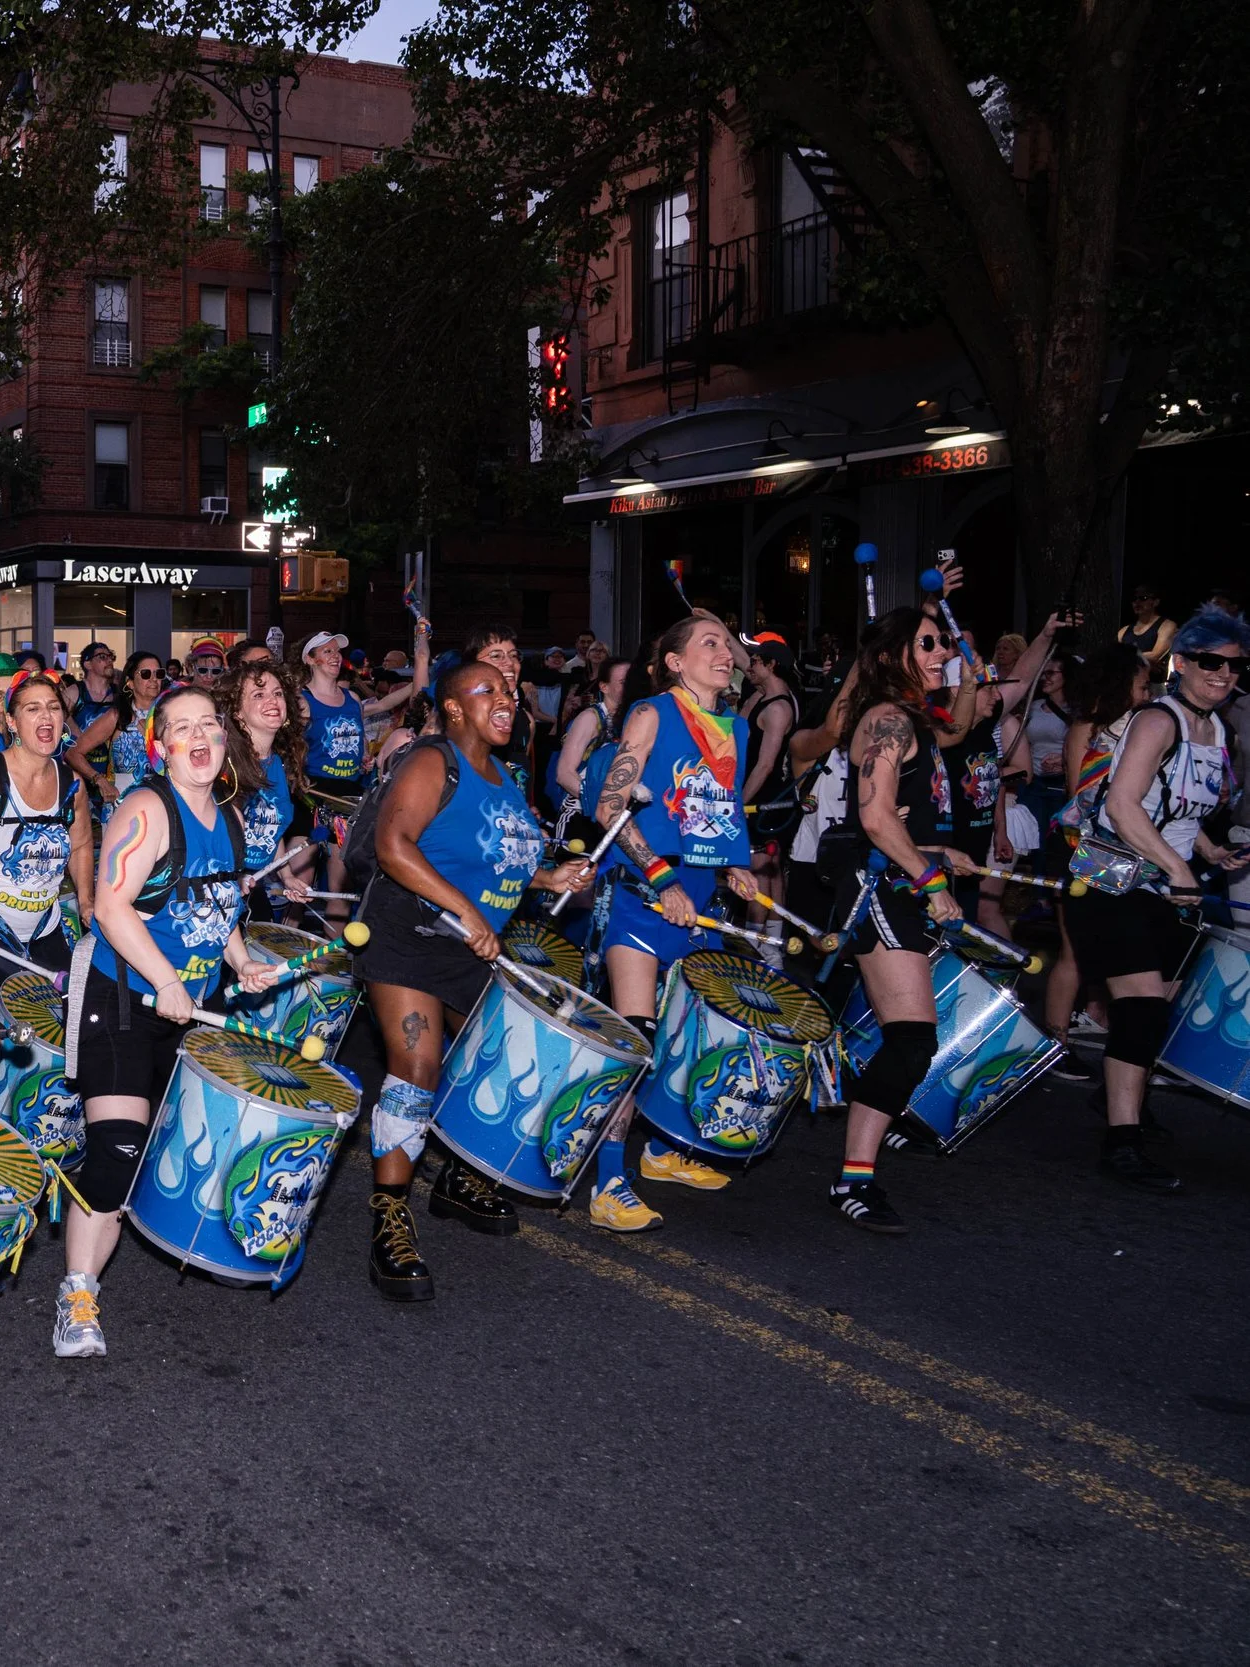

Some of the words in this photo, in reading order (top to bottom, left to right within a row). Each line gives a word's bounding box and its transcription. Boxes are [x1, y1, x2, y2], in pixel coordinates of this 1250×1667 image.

[610, 495, 635, 514] Kiku
[637, 491, 667, 510] Asian
[753, 479, 777, 496] Bar
[63, 559, 199, 592] LaserAway
[693, 844, 716, 854] NYC
[702, 1115, 739, 1138] FOGO
[247, 1220, 285, 1255] FOGO
